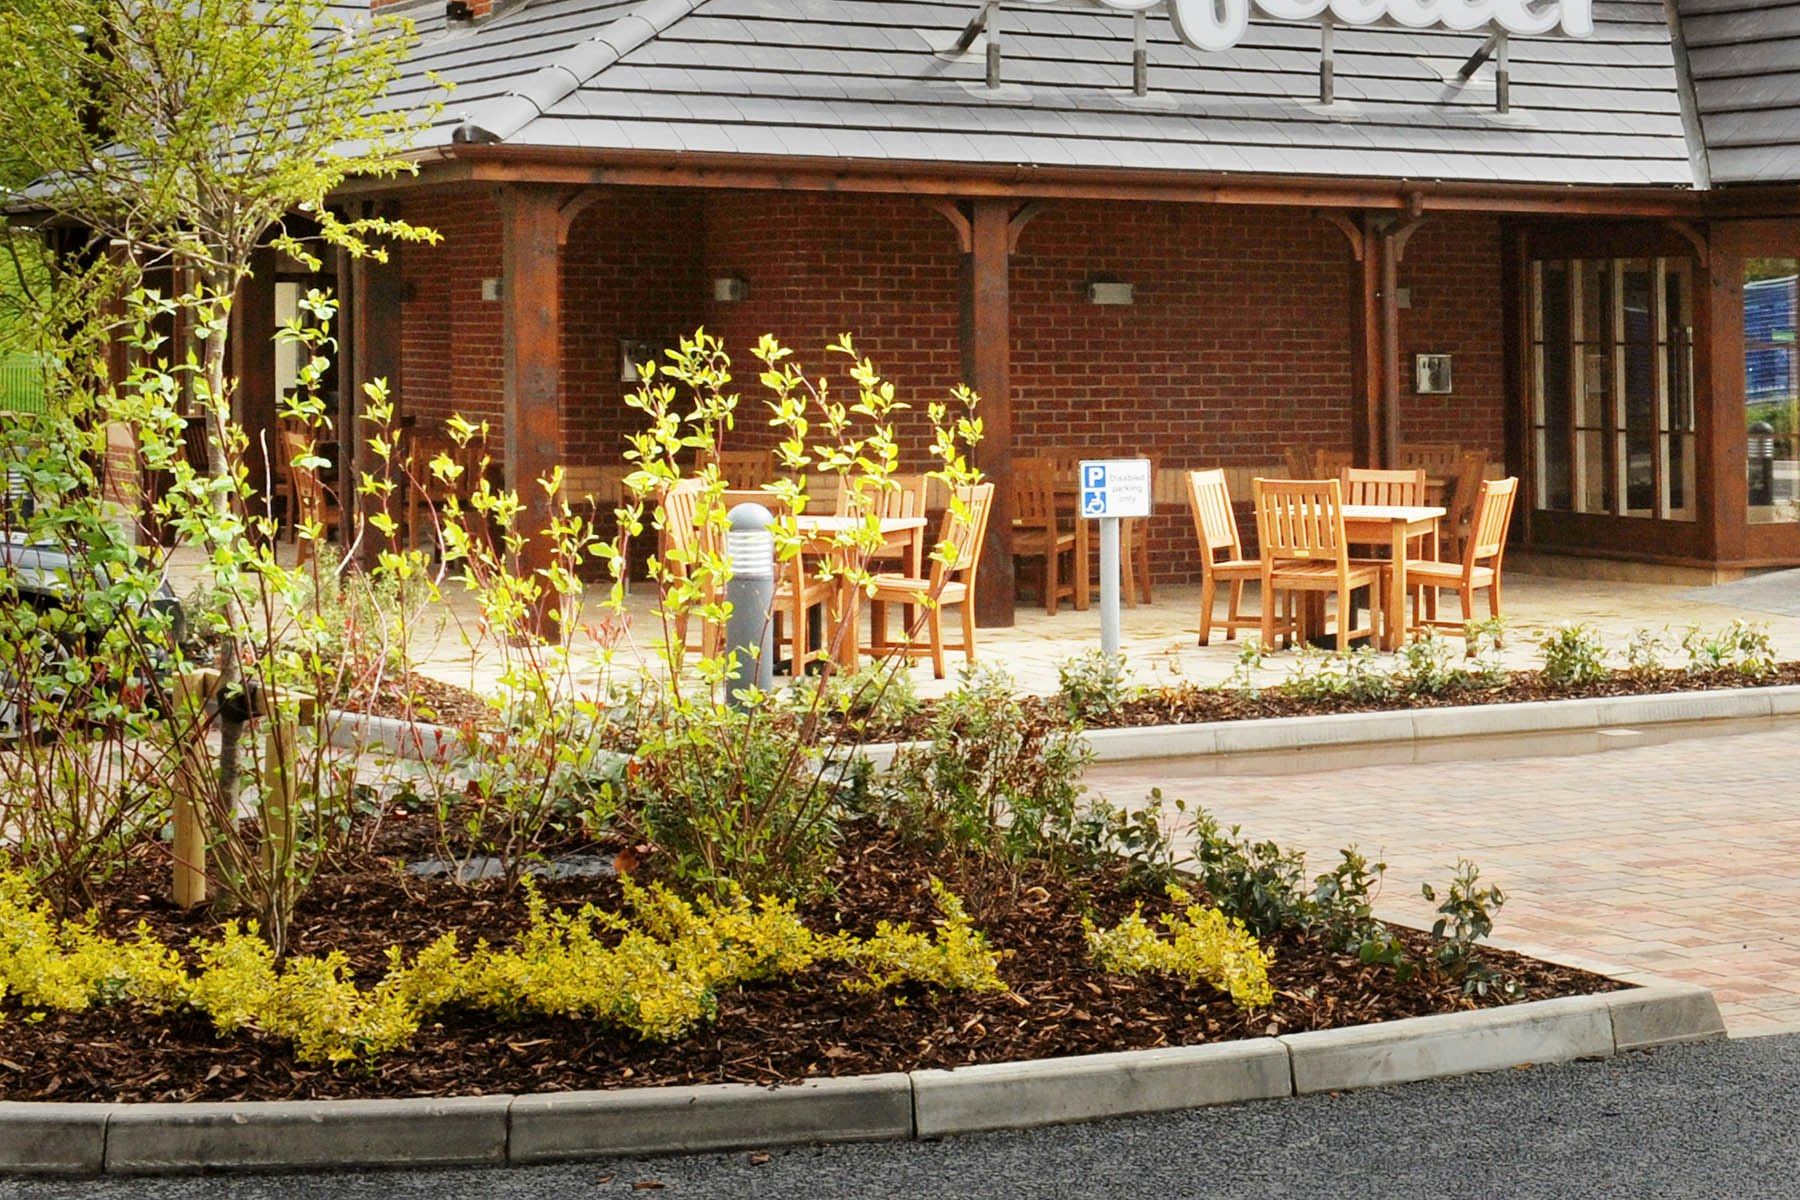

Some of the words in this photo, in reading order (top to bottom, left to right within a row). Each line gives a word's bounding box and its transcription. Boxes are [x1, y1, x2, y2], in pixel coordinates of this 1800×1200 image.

[1089, 467, 1104, 486] P
[1110, 474, 1145, 482] Disabled
[1112, 485, 1144, 494] parking
[1119, 496, 1136, 504] only
